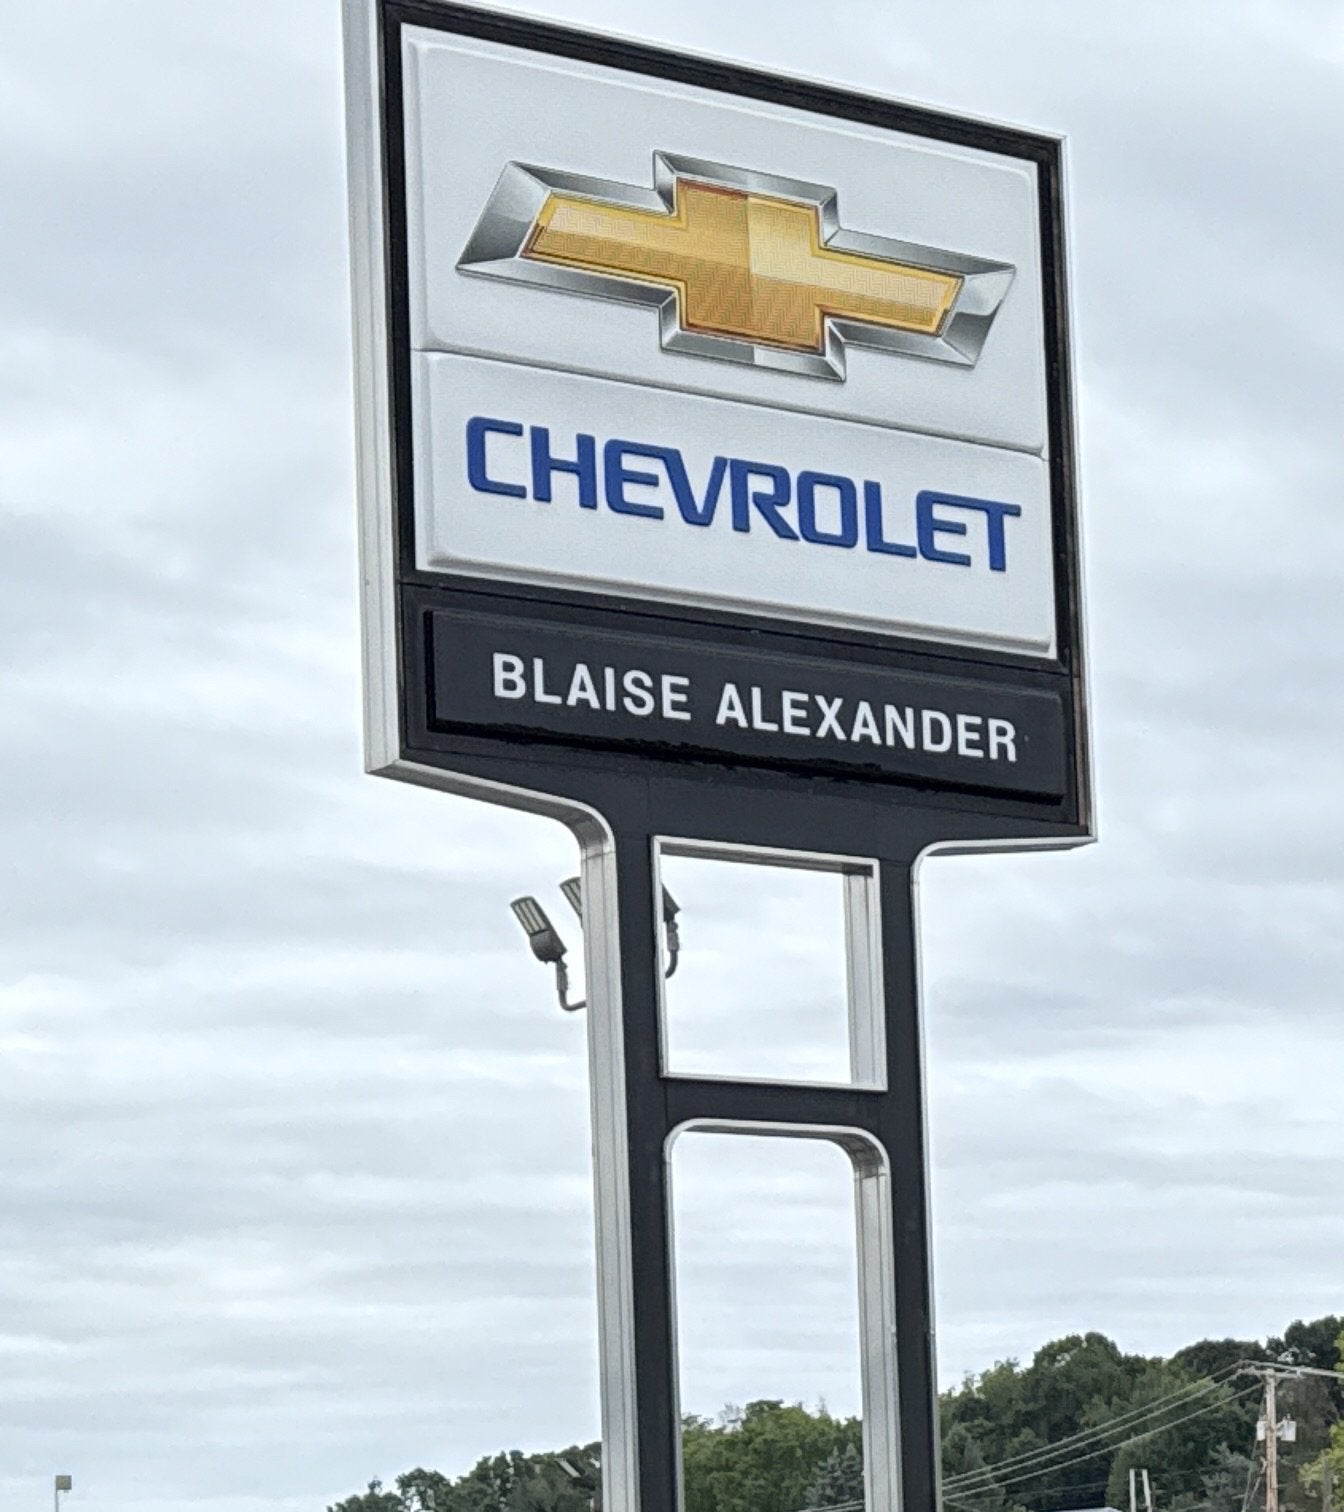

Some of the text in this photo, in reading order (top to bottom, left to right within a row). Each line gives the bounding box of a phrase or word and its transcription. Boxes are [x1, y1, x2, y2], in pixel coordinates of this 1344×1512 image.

[466, 415, 1022, 573] CHEVROLET
[492, 652, 1018, 763] BLAISE ALEXANDER
